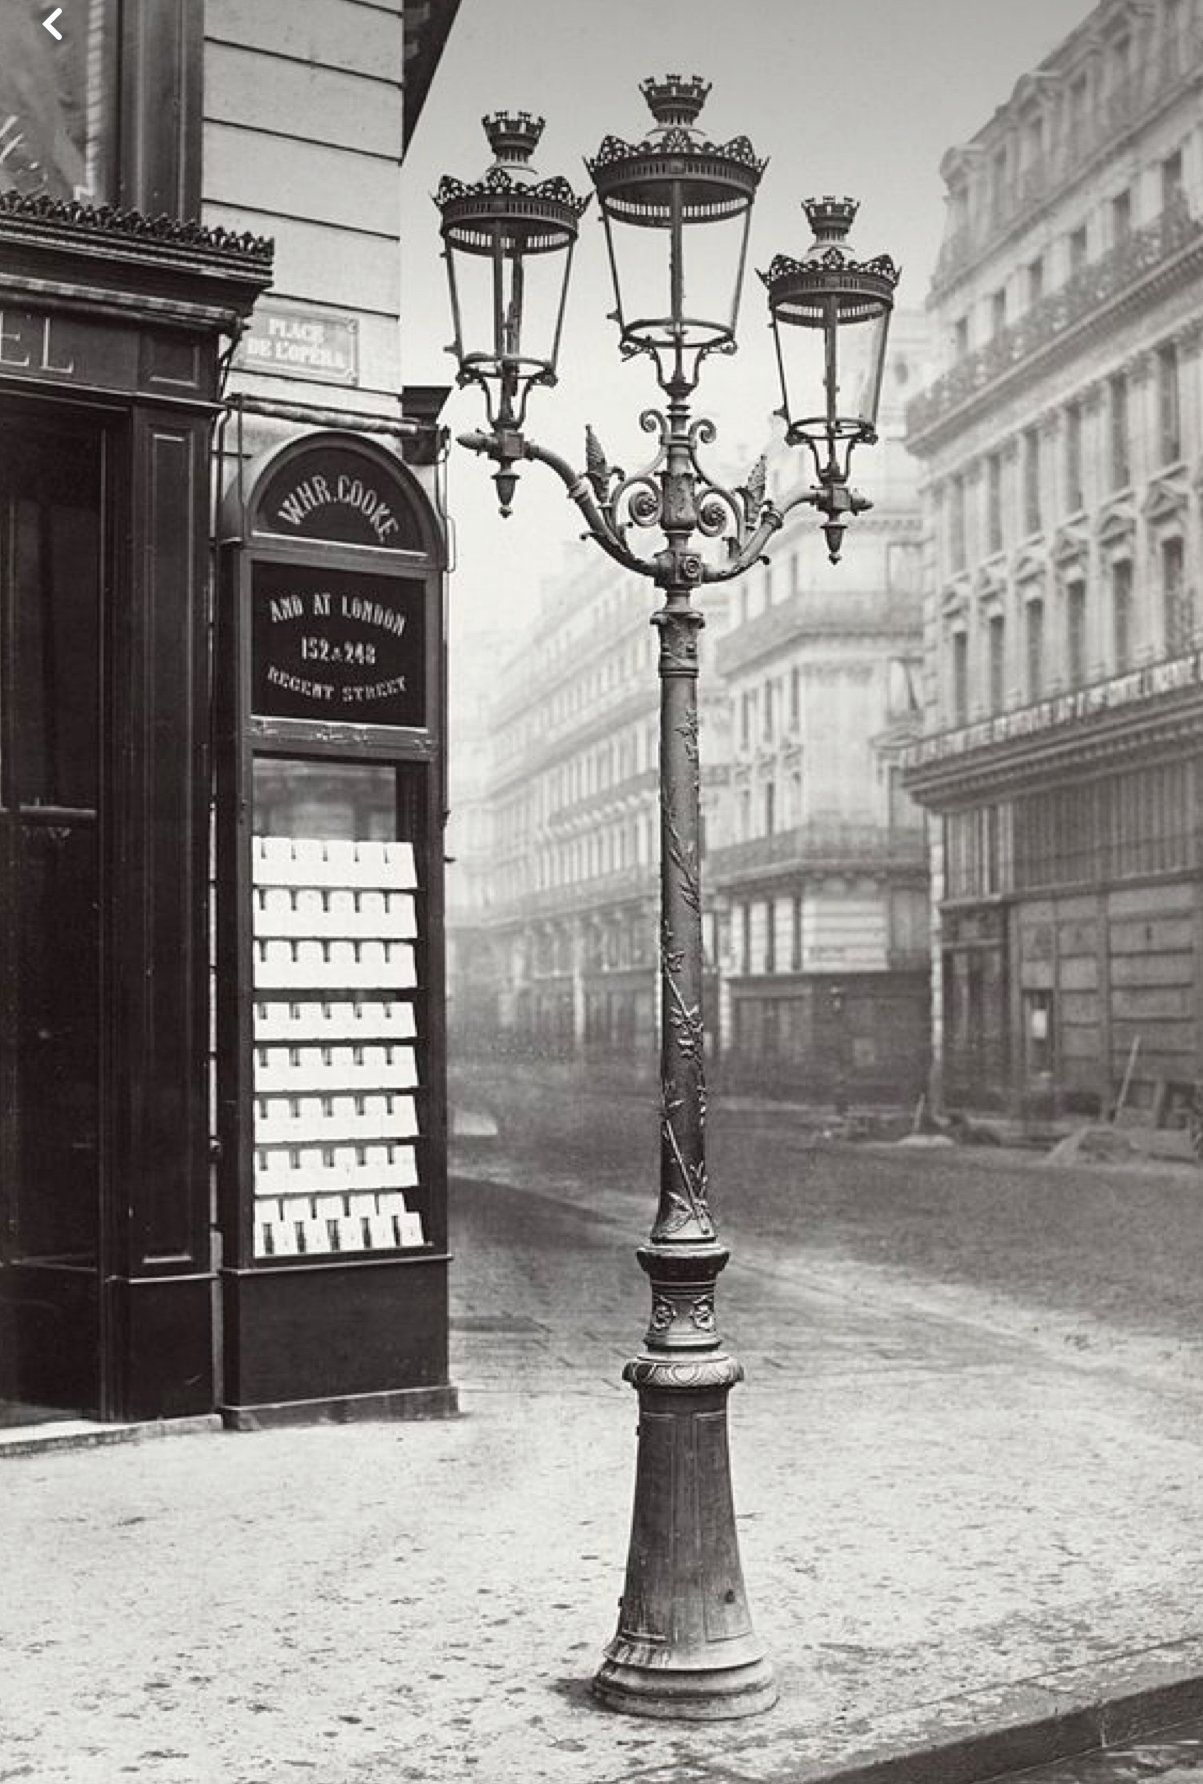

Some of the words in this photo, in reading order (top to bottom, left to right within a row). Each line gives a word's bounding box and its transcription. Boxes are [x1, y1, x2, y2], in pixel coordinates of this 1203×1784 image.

[268, 318, 325, 343] PLACE
[246, 337, 273, 356] DE
[269, 594, 304, 623] AND
[314, 592, 331, 616] AT
[341, 595, 406, 637] LONDON
[267, 665, 334, 700] REGENT
[341, 675, 406, 702] STREET
